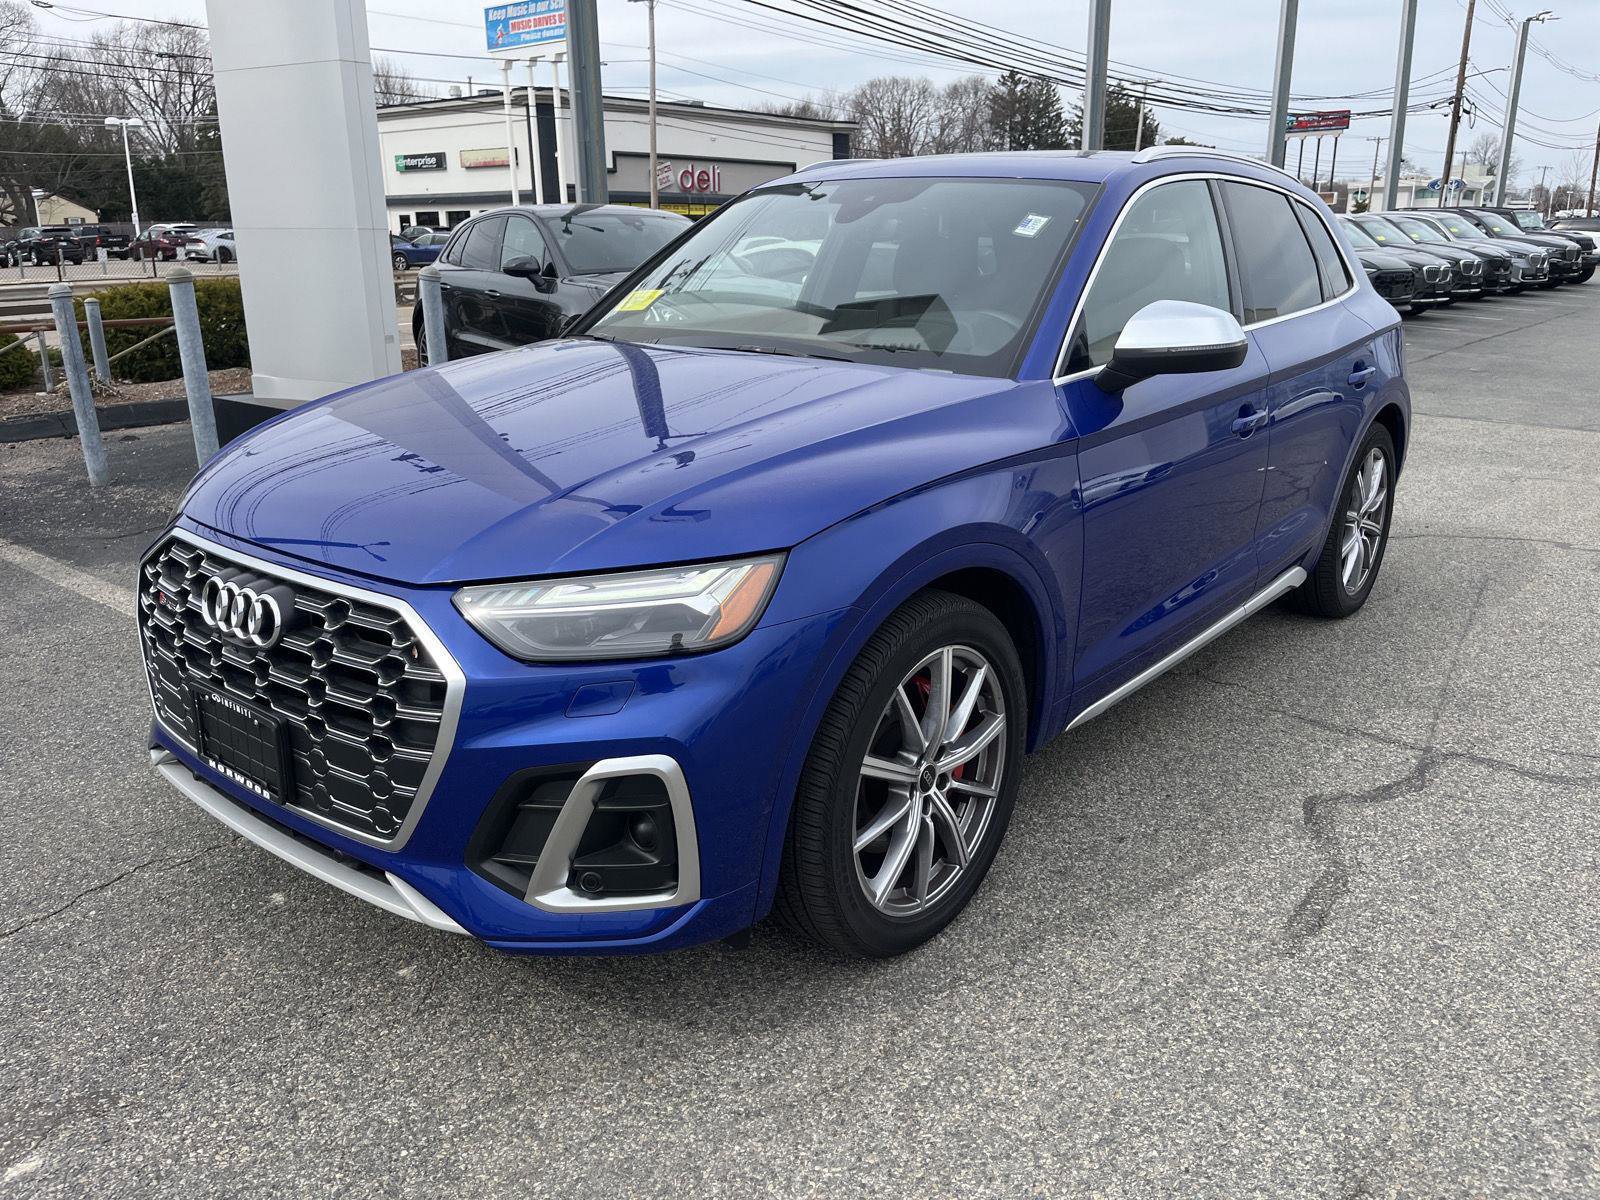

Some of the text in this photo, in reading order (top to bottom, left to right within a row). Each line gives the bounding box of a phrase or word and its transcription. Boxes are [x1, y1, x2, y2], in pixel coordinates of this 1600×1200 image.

[488, 8, 506, 21] Keep
[507, 5, 528, 17] Music
[511, 20, 532, 32] MUSIC
[533, 14, 557, 29] DRIVES
[395, 155, 437, 168] enterprise
[678, 163, 721, 192] deli
[221, 697, 252, 719] INFINITI
[208, 759, 271, 800] NORWOOD
